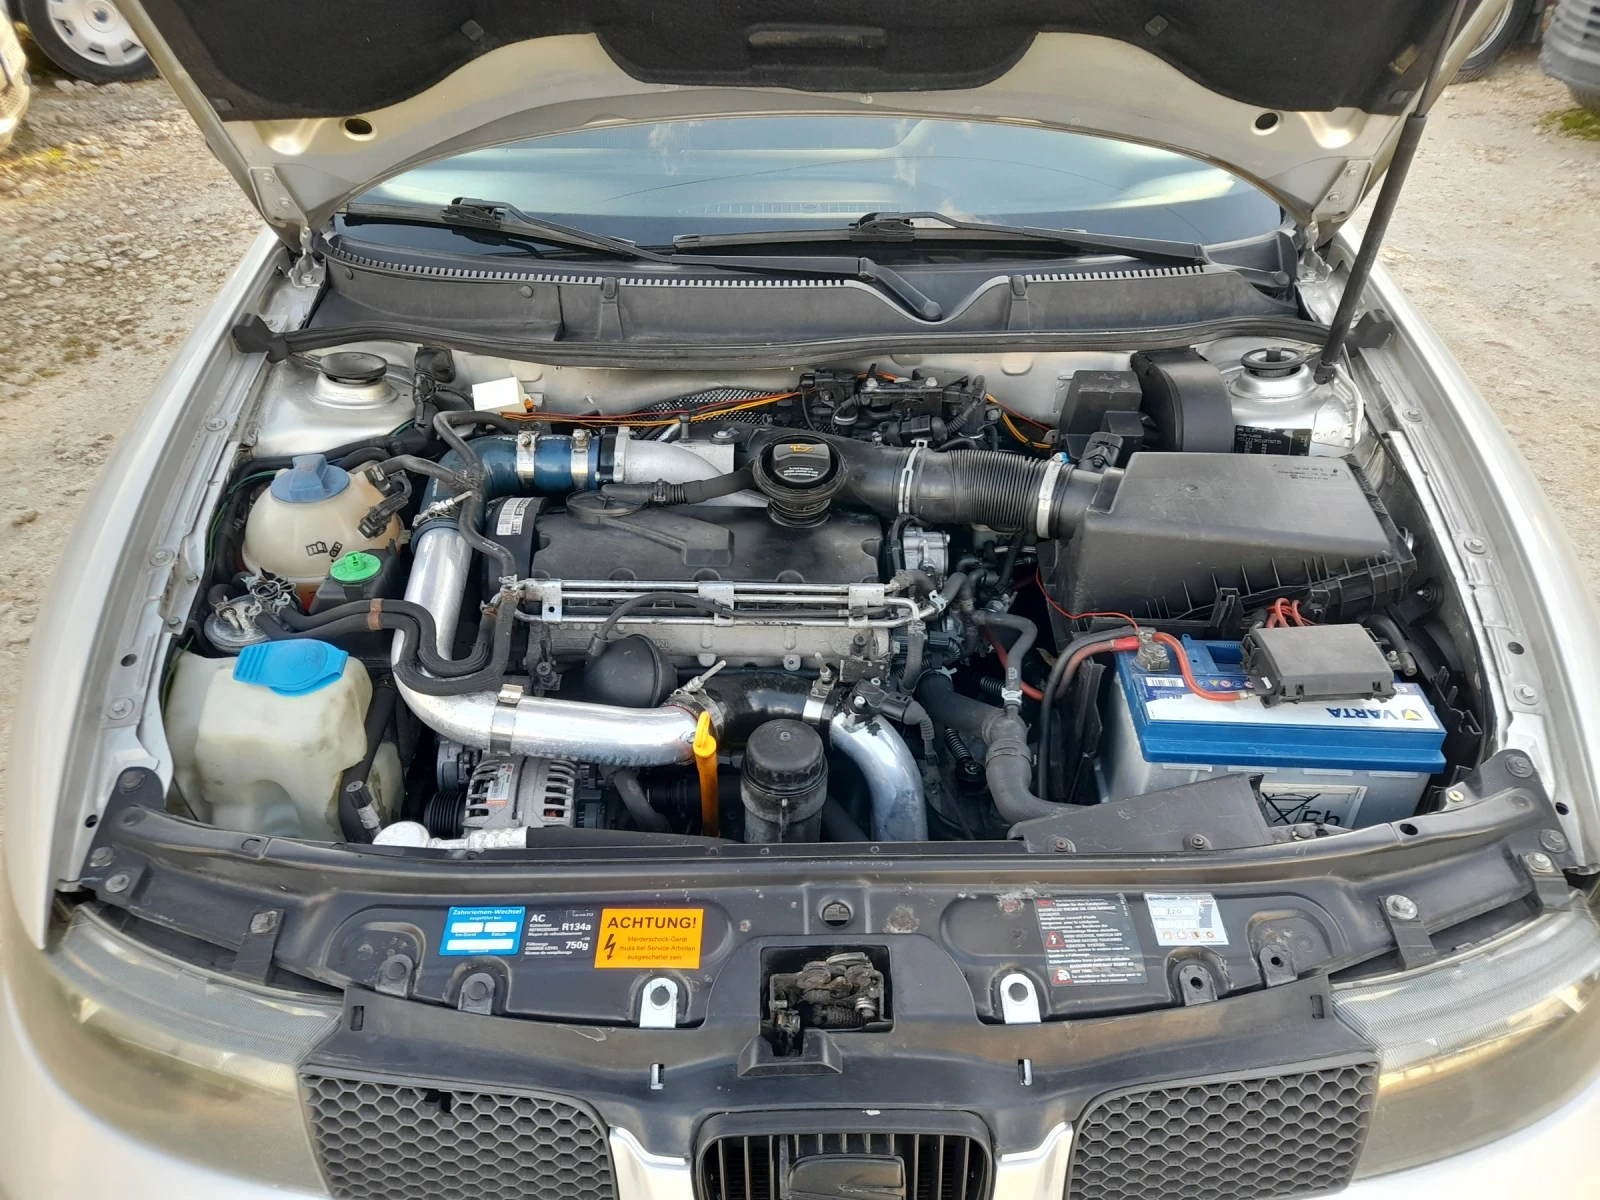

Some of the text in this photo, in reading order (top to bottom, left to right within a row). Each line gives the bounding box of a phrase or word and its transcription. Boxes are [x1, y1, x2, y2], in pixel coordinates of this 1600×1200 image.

[330, 542, 342, 556] G12
[1325, 707, 1398, 721] VARTA
[530, 914, 546, 922] AC
[607, 917, 696, 928] ACHTUNG!
[562, 923, 591, 931] R134a
[565, 941, 589, 950] 750g
